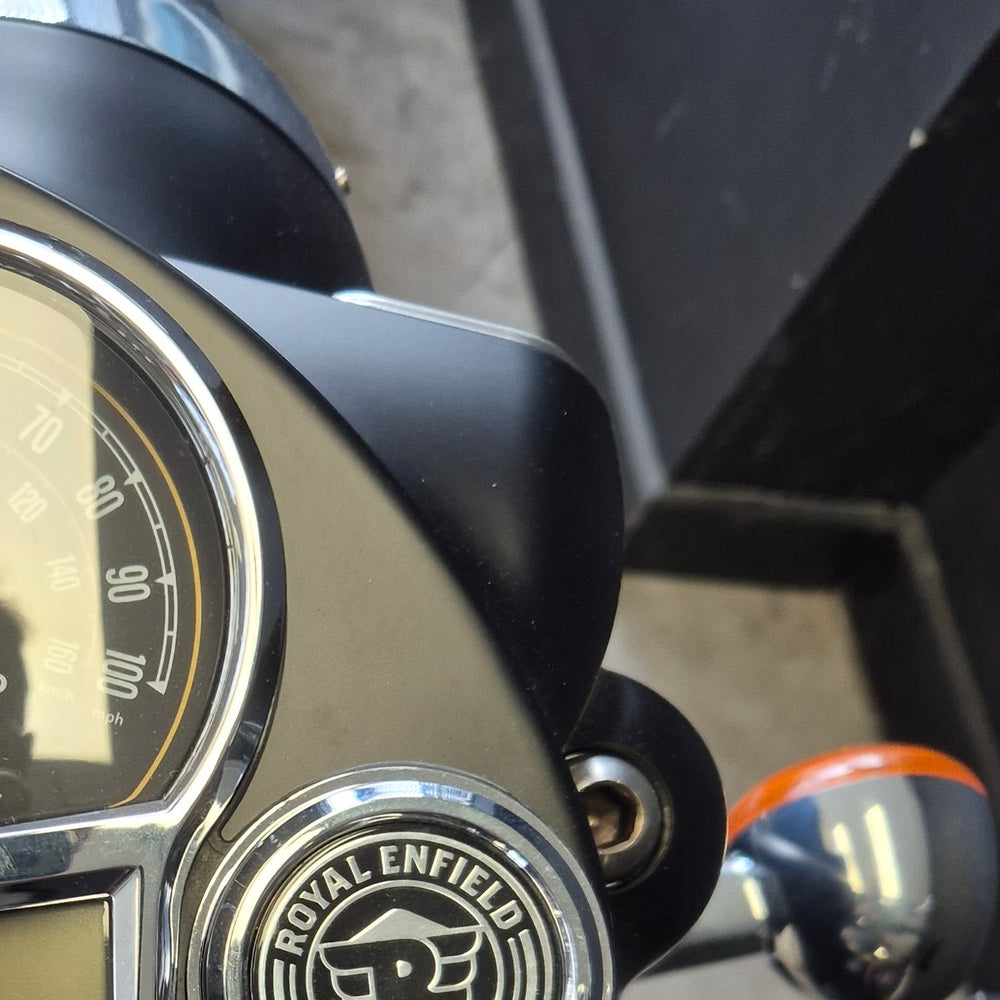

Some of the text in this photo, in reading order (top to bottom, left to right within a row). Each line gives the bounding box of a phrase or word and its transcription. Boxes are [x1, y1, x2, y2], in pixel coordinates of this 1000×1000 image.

[17, 403, 64, 454] 70
[7, 481, 48, 523] 120
[76, 474, 124, 520] 80
[45, 553, 80, 593] 140
[106, 563, 151, 604] 90
[43, 637, 80, 675] 160
[97, 649, 147, 700] 100
[275, 844, 524, 956] ROYAL ENFIELD
